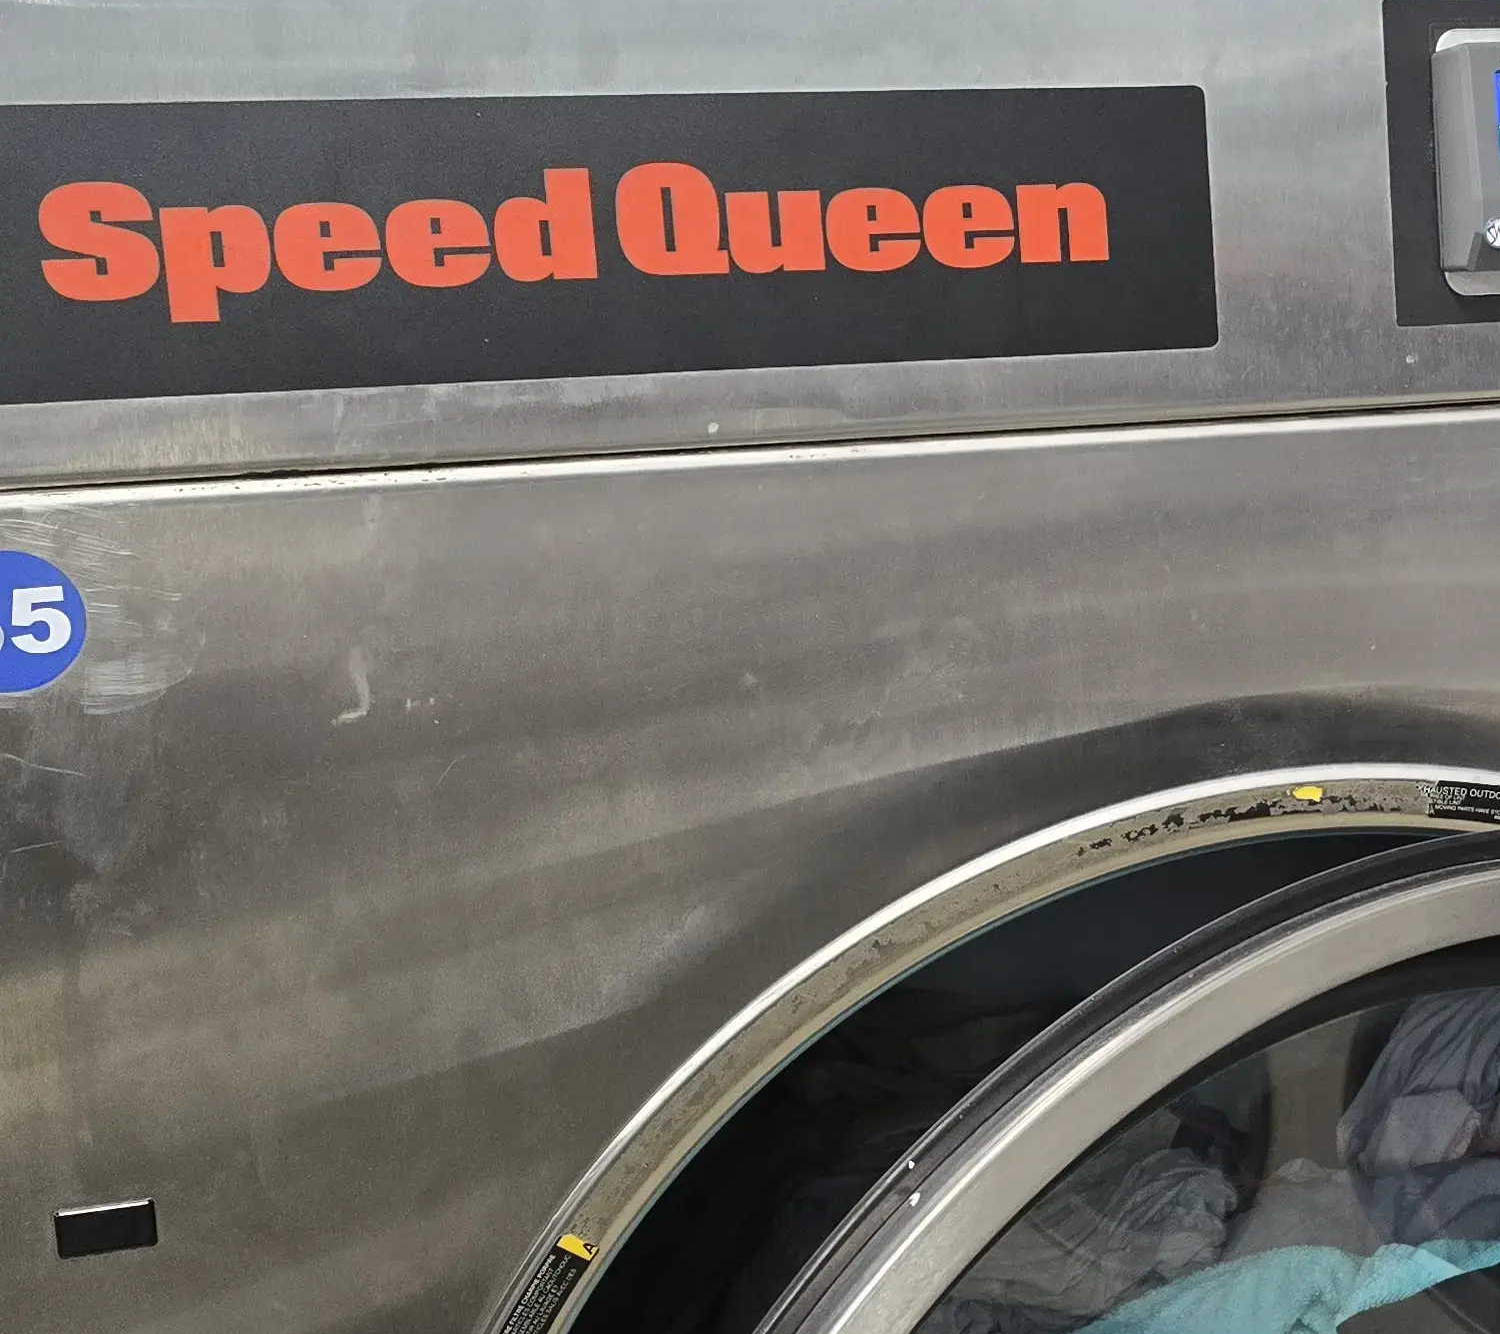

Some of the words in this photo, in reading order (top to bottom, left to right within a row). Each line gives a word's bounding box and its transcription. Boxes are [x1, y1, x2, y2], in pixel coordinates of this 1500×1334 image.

[39, 167, 598, 323] Speed
[615, 162, 1110, 276] Queen
[0, 586, 71, 654] 5
